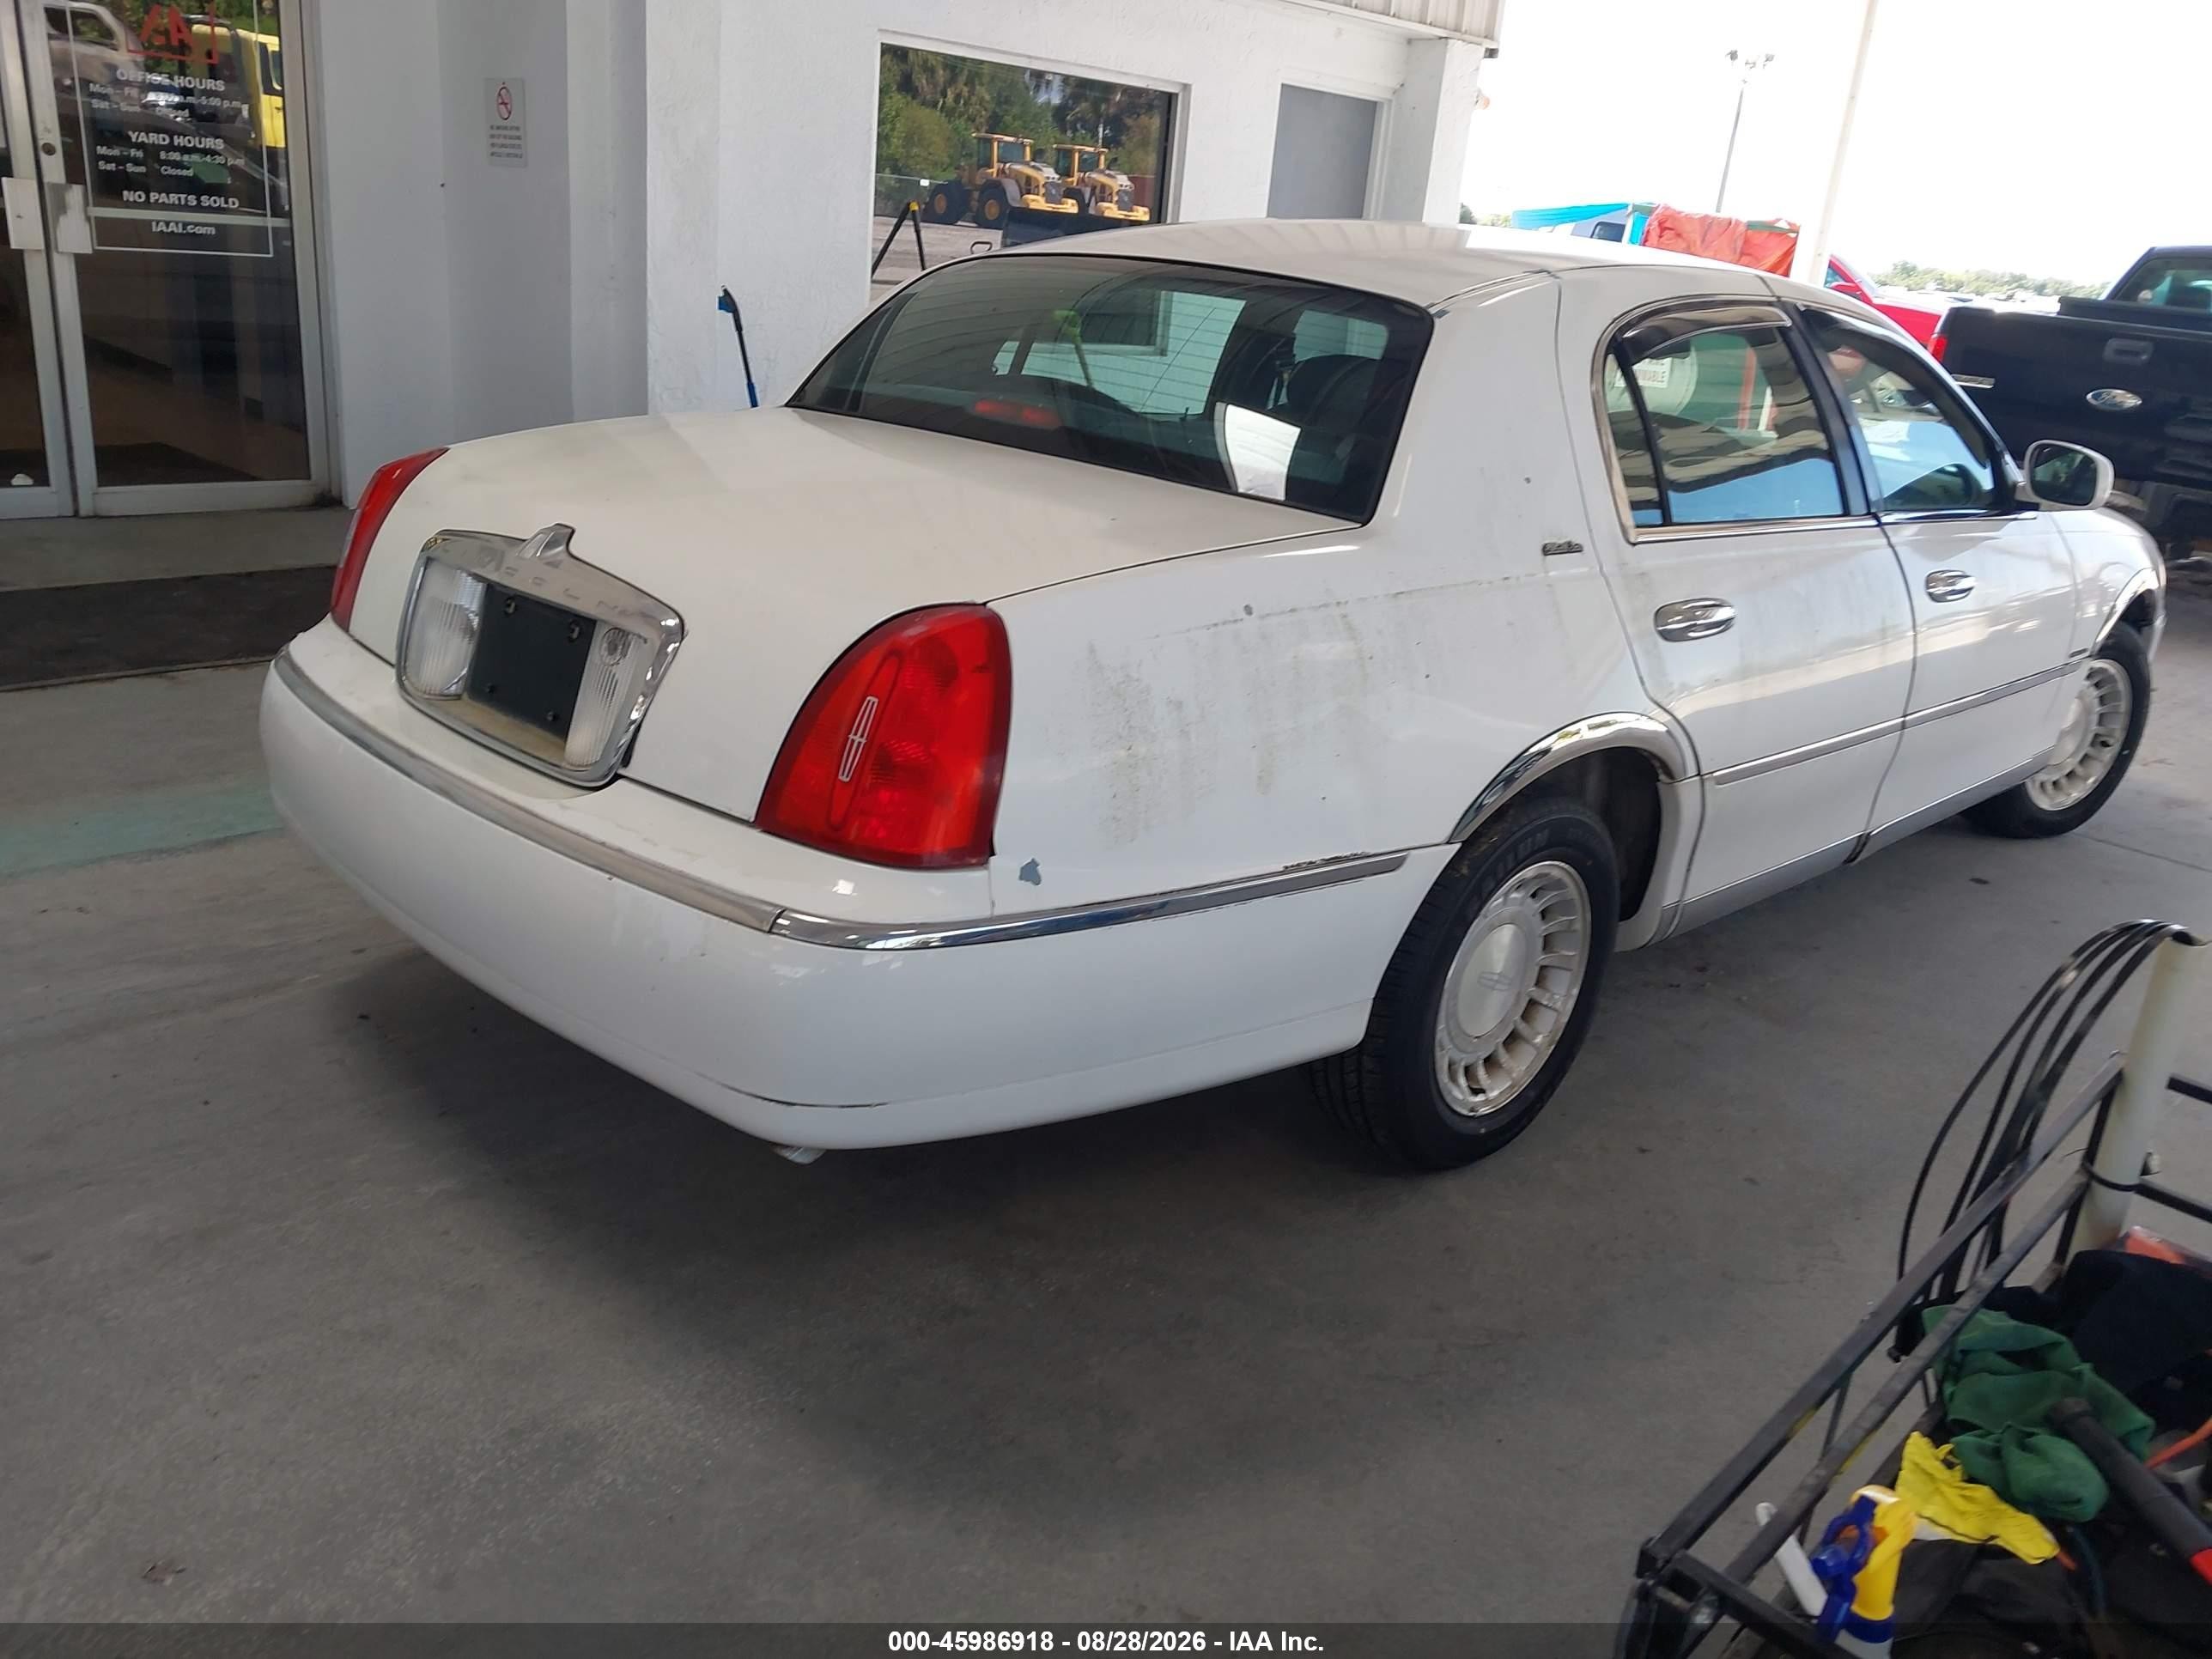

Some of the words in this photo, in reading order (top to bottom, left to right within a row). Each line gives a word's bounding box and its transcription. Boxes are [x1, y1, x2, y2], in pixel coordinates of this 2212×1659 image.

[116, 69, 171, 85] OFFICE
[173, 75, 226, 91] HOURS
[89, 83, 113, 94] Mon
[91, 99, 110, 109] Sat
[128, 131, 170, 145] YARD
[173, 135, 225, 149] HOURS
[96, 145, 120, 156] Mon
[131, 149, 144, 158] Fri
[98, 161, 116, 171] Sat
[126, 163, 147, 173] Sun
[161, 165, 193, 177] Closed
[123, 191, 146, 203] NO
[149, 192, 198, 206] PARTS
[200, 196, 240, 209] SOLD
[151, 221, 216, 235] IAAI.com
